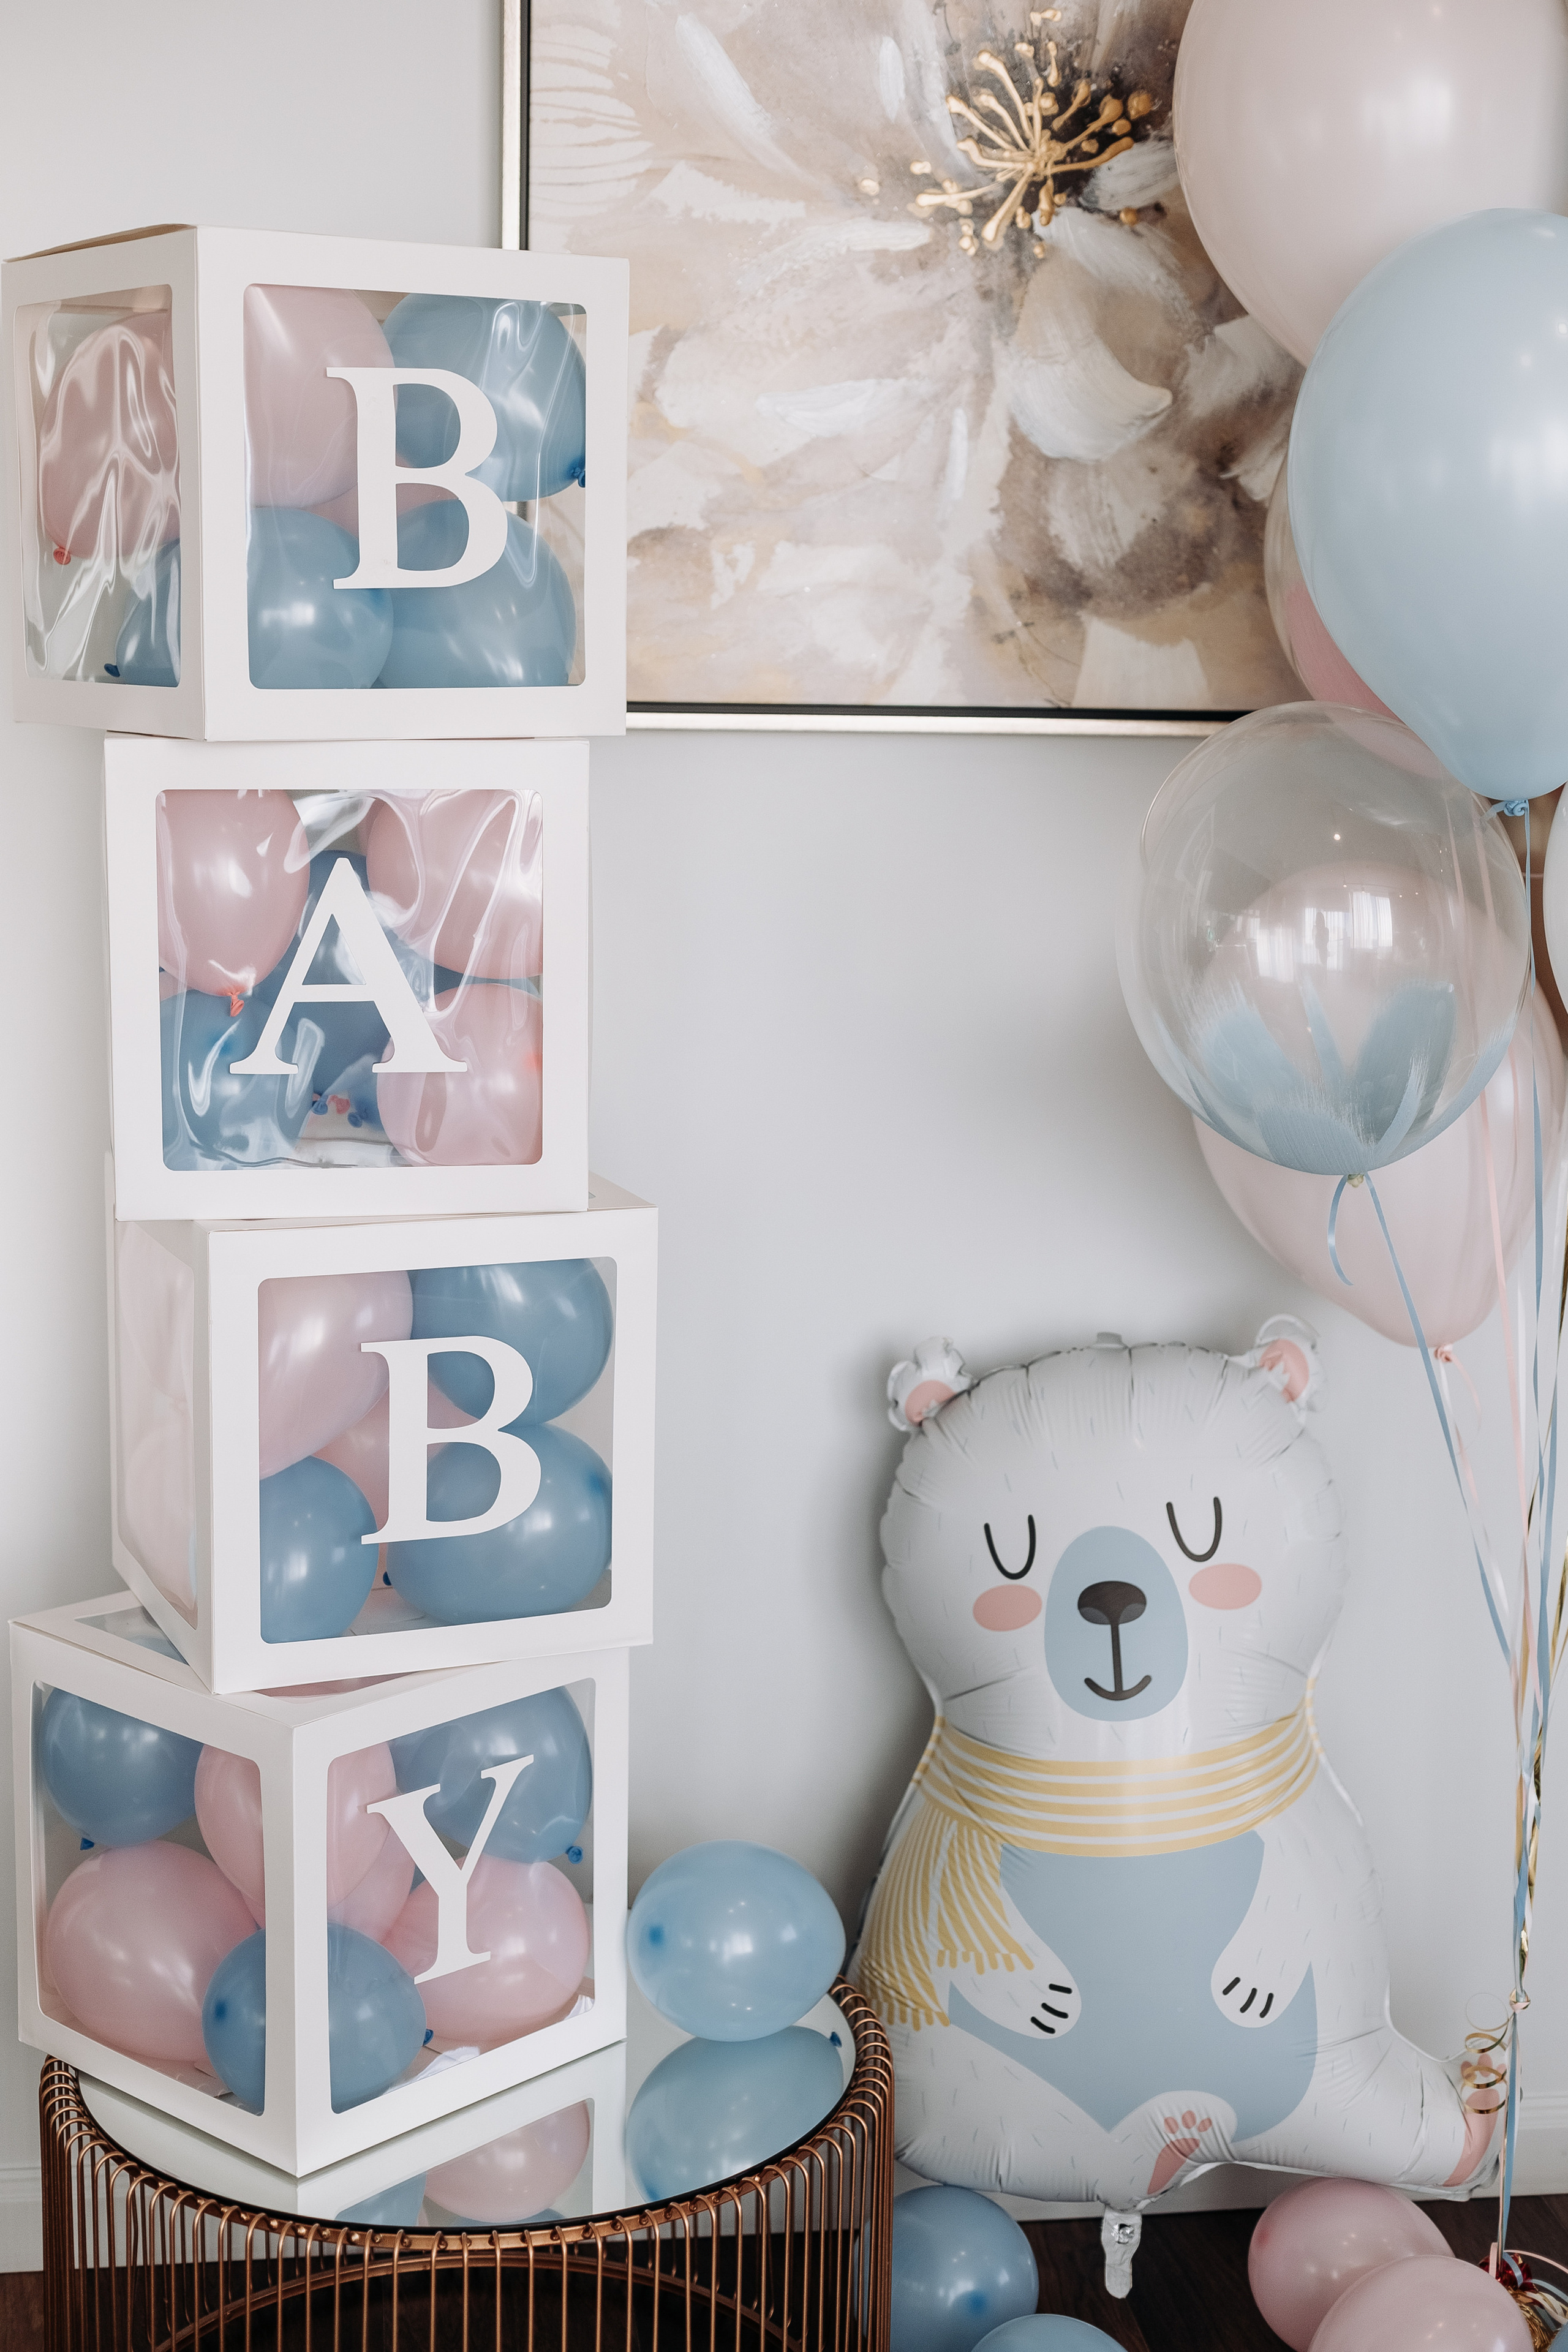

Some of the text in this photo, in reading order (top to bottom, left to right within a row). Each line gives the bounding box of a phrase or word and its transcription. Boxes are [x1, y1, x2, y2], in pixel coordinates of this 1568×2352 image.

[326, 367, 508, 589] B
[230, 858, 467, 1073] A
[360, 1335, 541, 1544] B
[367, 1754, 534, 1985] Y
